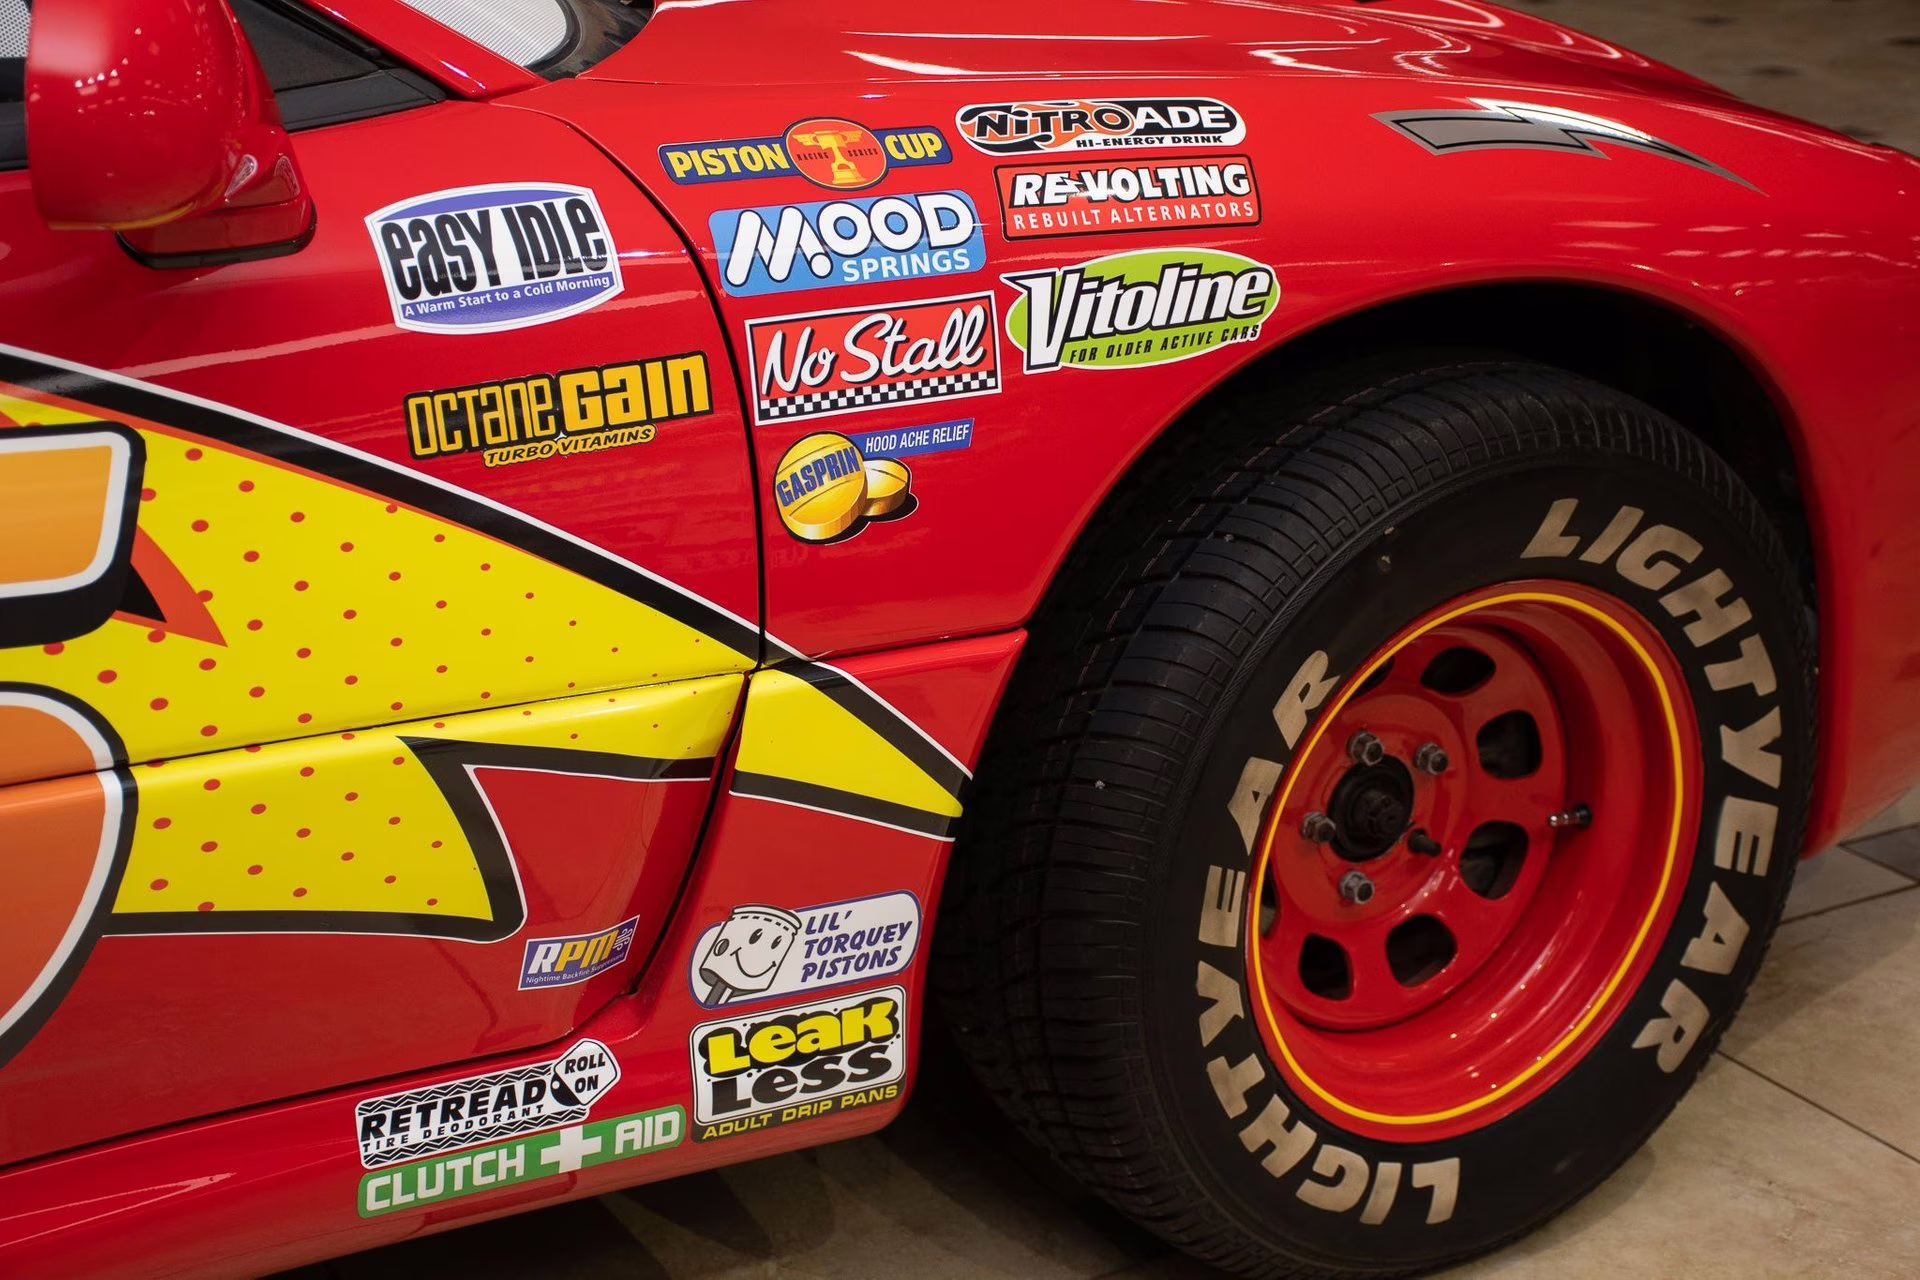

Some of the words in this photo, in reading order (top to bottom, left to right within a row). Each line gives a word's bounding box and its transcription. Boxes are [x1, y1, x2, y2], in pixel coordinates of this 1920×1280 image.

[666, 143, 789, 178] PISTON
[884, 132, 943, 160] CUP
[1076, 136, 1165, 148] HI-ENERGY
[1172, 134, 1223, 144] DRINK
[1013, 209, 1101, 230] REBUILT
[1110, 201, 1254, 224] ALTERNATORS
[725, 192, 976, 287] MOOD
[842, 248, 970, 282] SPRINGS
[404, 305, 415, 317] A
[416, 300, 456, 315] Warm
[458, 292, 493, 308] Start
[494, 290, 510, 301] to
[513, 290, 522, 299] a
[524, 282, 554, 298] Cold
[556, 275, 611, 292] Morning
[1008, 263, 1274, 371] Vitoline
[761, 326, 839, 397] No
[840, 304, 988, 384] Stall
[1069, 347, 1098, 364] FOR
[1106, 339, 1151, 358] OLDER
[1161, 331, 1214, 350] ACTIVE
[1221, 324, 1260, 342] CARS
[487, 444, 553, 463] TURBO
[559, 428, 653, 454] VITAMINS
[866, 434, 897, 453] HOOD
[899, 430, 930, 449] ACHE
[932, 424, 970, 444] RELIEF
[776, 446, 861, 508] GASPRIN
[1520, 498, 1783, 1075] LIGHTYEAR
[804, 921, 913, 959] TORQUEY
[1195, 649, 1462, 1226] LIGHTYEAR
[801, 946, 902, 983] PISTONS
[564, 1052, 607, 1075] ROLL
[574, 1075, 599, 1094] ON
[360, 1078, 548, 1142] RETREAD
[363, 1134, 410, 1153] TIRE
[423, 1104, 544, 1139] DEODORANT
[702, 1112, 774, 1140] ADULT
[781, 1099, 833, 1123] DRIP
[841, 1085, 899, 1110] PANS
[366, 1145, 526, 1212] CLUTCH
[614, 1110, 681, 1155] AID
